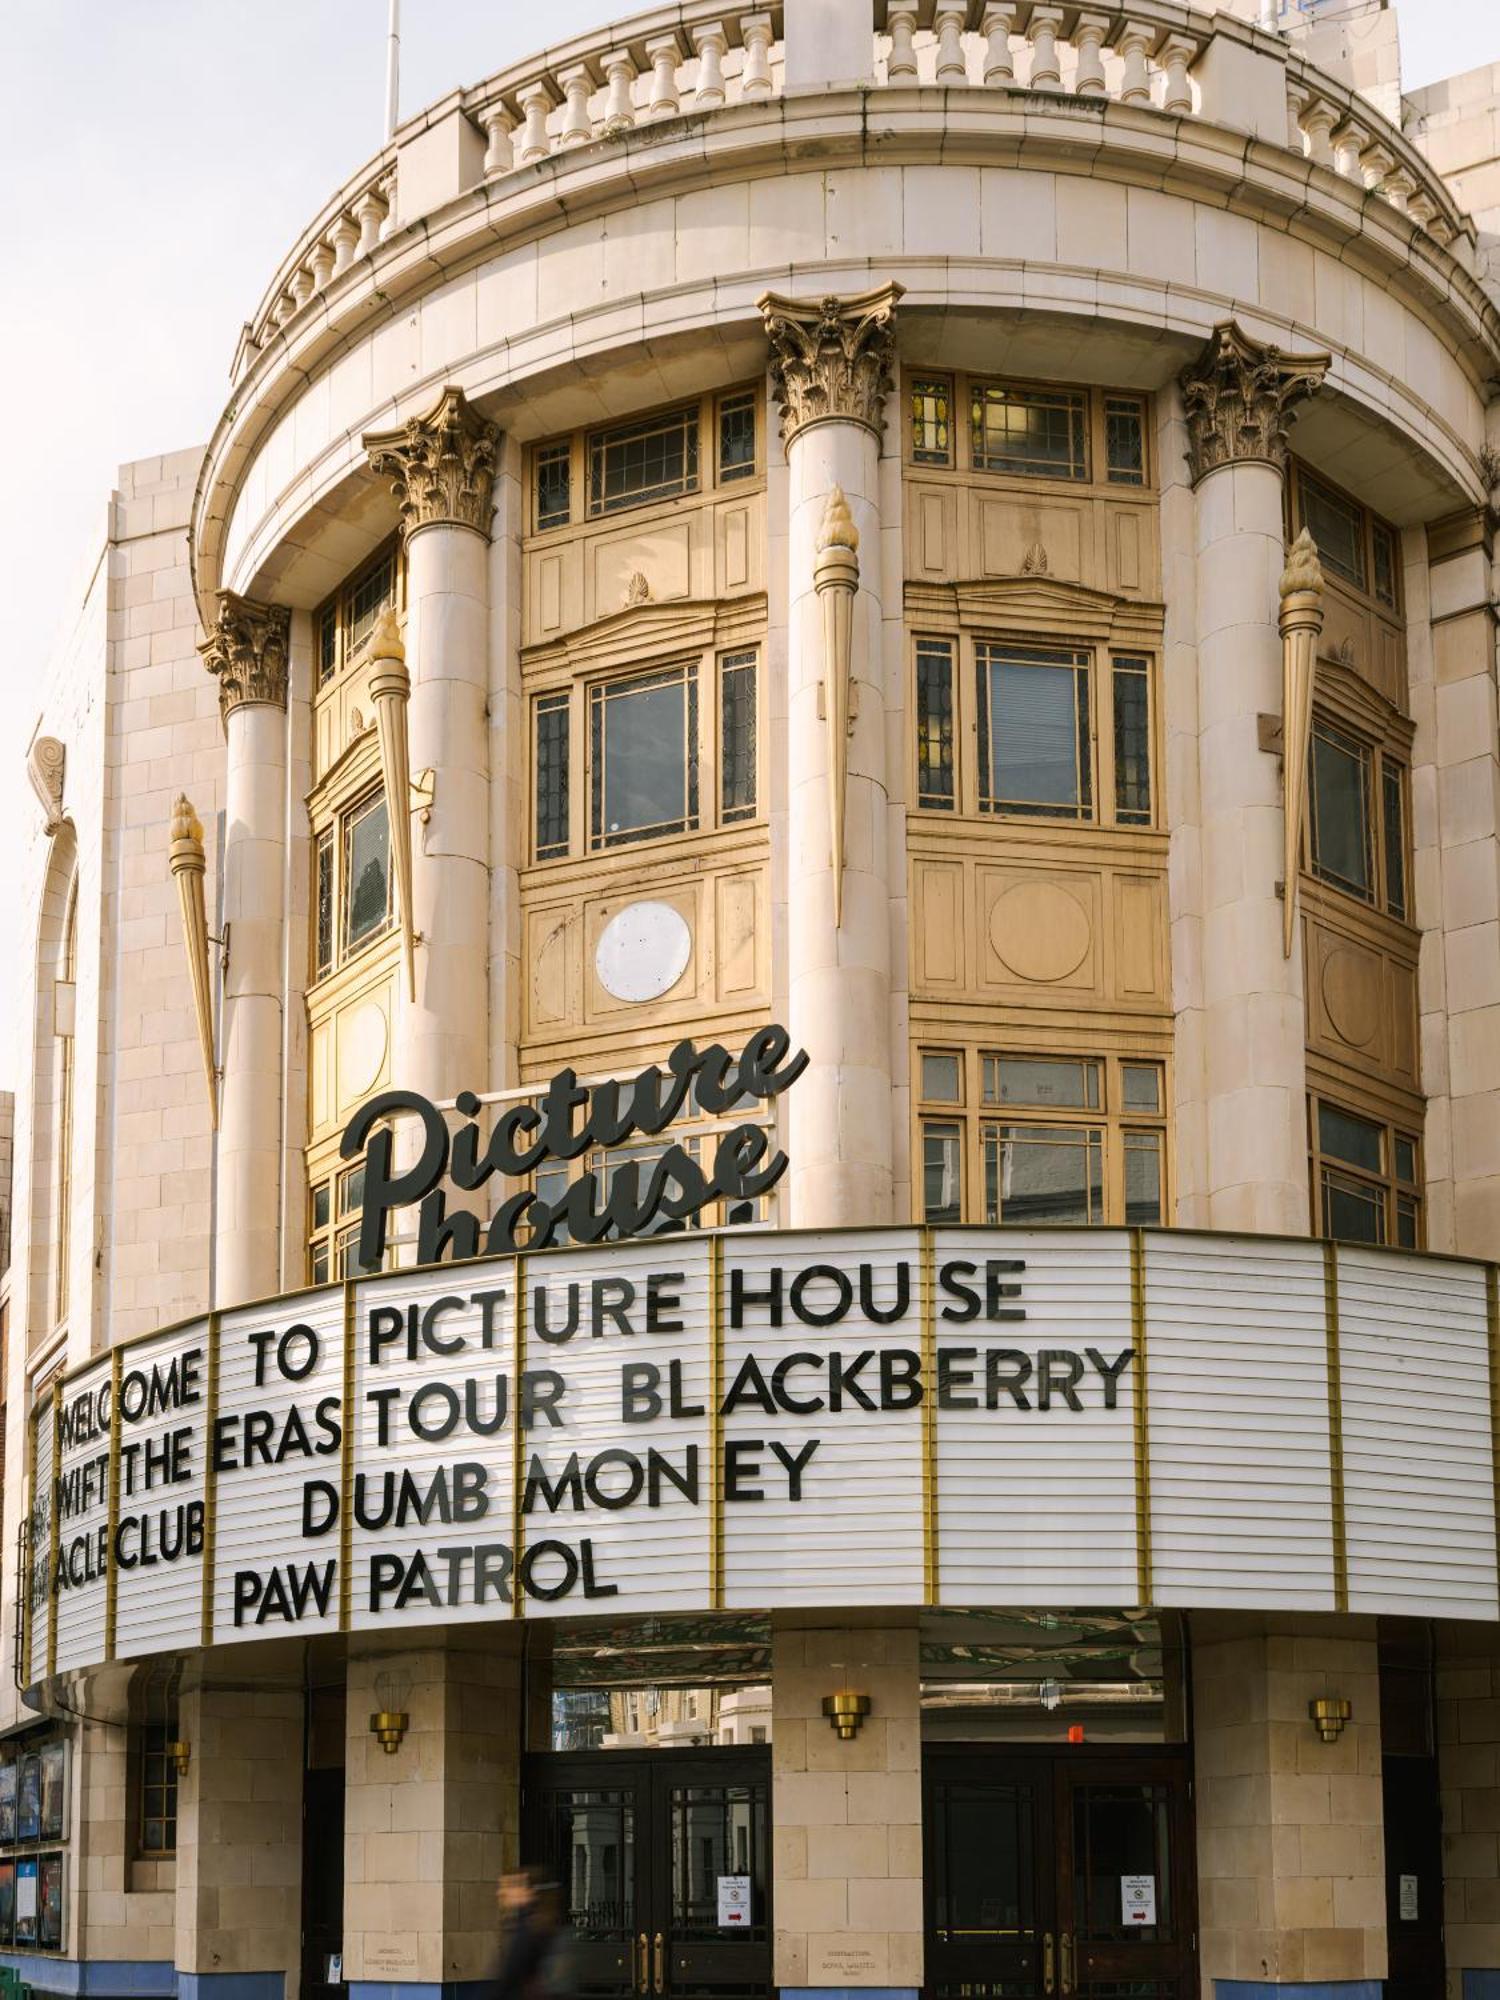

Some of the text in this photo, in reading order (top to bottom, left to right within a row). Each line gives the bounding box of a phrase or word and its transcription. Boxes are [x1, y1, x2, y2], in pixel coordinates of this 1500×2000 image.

[340, 1024, 810, 1269] Picture
[417, 1123, 789, 1264] house
[57, 1349, 202, 1450] WELCOME
[248, 1324, 319, 1386] TO
[731, 1260, 1026, 1328] HOUSE
[50, 1347, 1136, 1521] WIFT THE ERAS TOUR BLACKBERRY
[114, 1500, 205, 1569] CLUB
[302, 1462, 489, 1538] DUMB
[521, 1439, 820, 1513] MONEY
[234, 1538, 618, 1627] PAW PATROL
